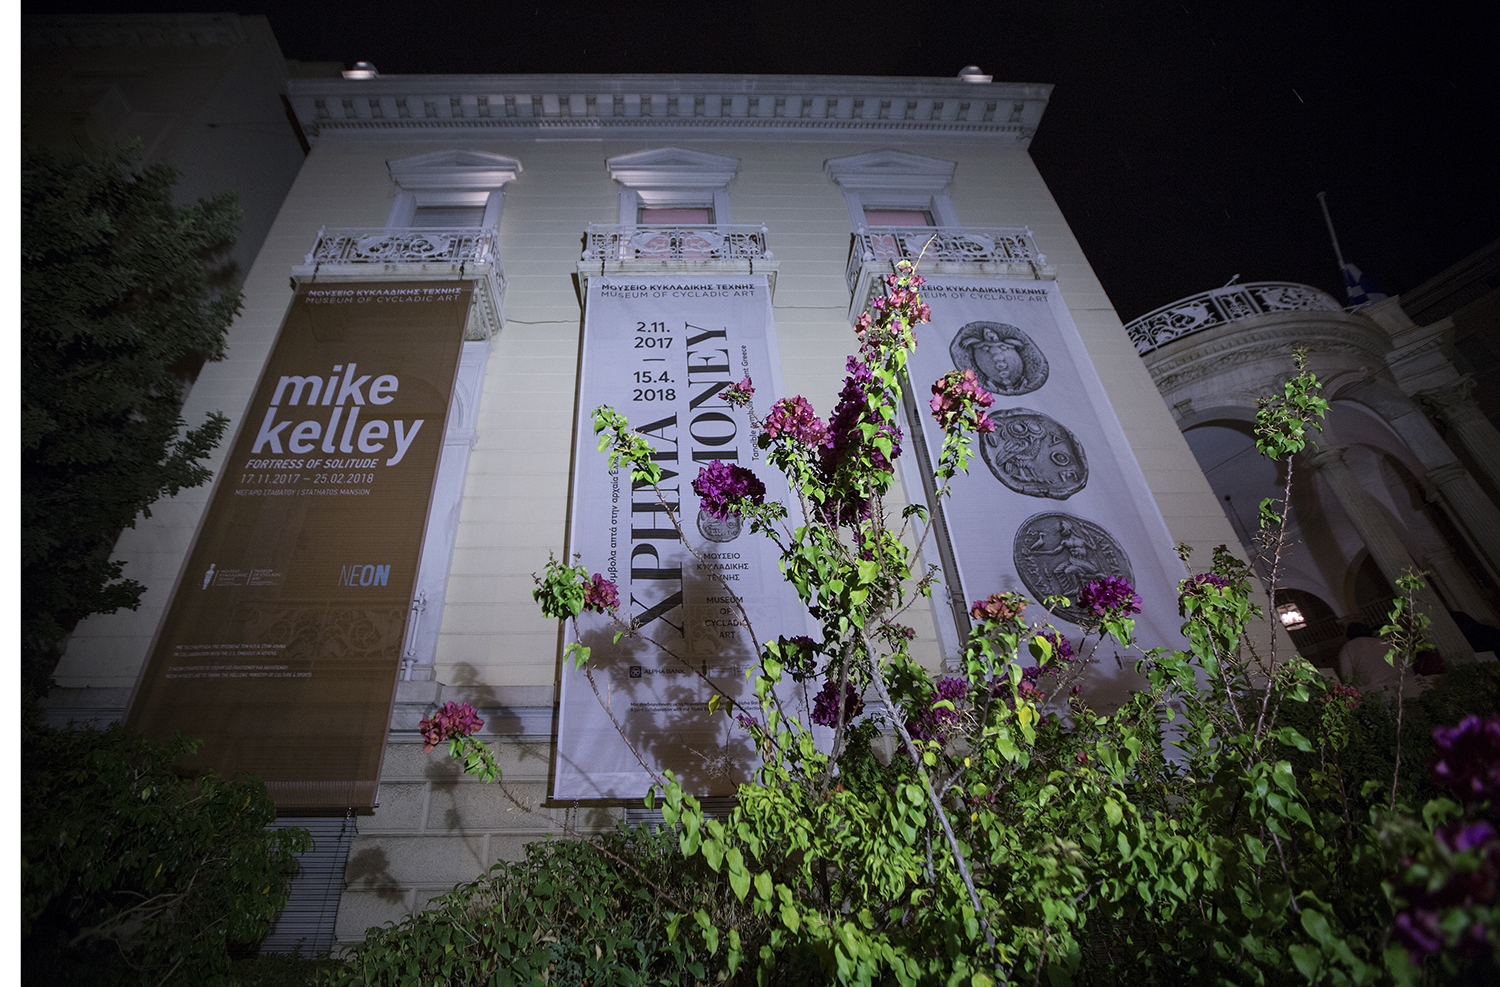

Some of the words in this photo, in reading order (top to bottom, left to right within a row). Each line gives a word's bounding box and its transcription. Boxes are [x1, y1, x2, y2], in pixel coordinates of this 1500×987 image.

[422, 287, 462, 295] ΤΕΧΝΗΣ
[601, 291, 649, 299] MUSEUM
[672, 290, 729, 298] CYCLADIC
[970, 292, 1025, 301] CYCLADIC
[1009, 287, 1049, 295] ΤΕΧΝΗΣ
[357, 296, 373, 304] OF
[376, 295, 434, 303] CYCLADIC
[437, 294, 460, 302] ART
[636, 321, 671, 333] 2.11.
[634, 337, 673, 349] 2017
[741, 344, 749, 366] Greece
[633, 371, 675, 383] 15.4.
[270, 363, 399, 406] mike
[632, 389, 676, 401] 2018
[251, 406, 424, 467] kelley
[245, 459, 304, 469] FORTRESS
[306, 459, 323, 469] OF
[323, 458, 379, 469] SOLITUDE
[241, 473, 300, 484] 17.11.2017
[313, 473, 374, 484] 25.02.2018
[340, 488, 370, 496] MANSION
[611, 505, 619, 525] στην
[703, 552, 741, 560] ΜΟΥΣΕΙΟ
[338, 565, 391, 587] NEON
[706, 596, 744, 604] MUSEUM
[719, 607, 732, 615] OF
[719, 631, 736, 639] ART
